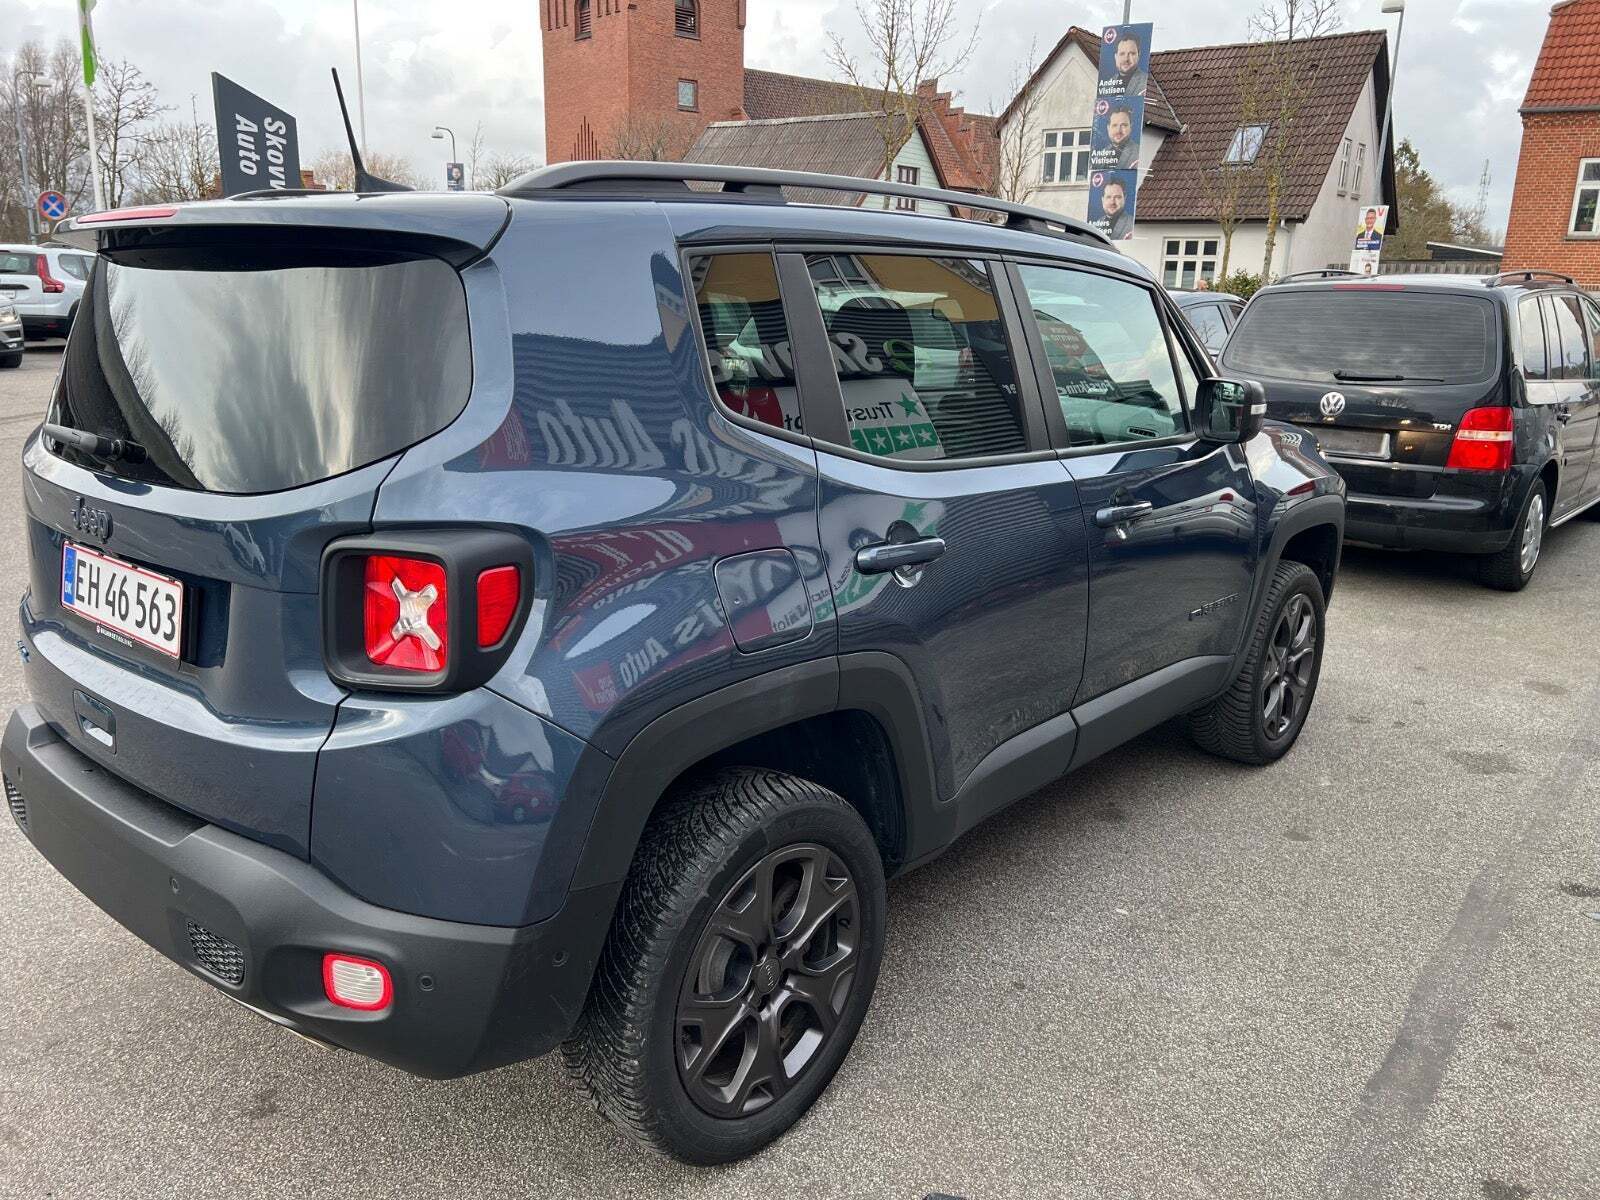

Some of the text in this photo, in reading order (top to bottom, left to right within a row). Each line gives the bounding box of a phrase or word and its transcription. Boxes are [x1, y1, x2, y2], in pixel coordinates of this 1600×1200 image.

[1100, 79, 1123, 87] Anders
[1099, 87, 1126, 95] Vistisen
[235, 113, 261, 176] Auto
[1091, 149, 1116, 157] Anders
[1091, 157, 1119, 165] Vistisen
[75, 558, 101, 609] EH
[105, 572, 130, 622] 46
[135, 581, 177, 642] 563
